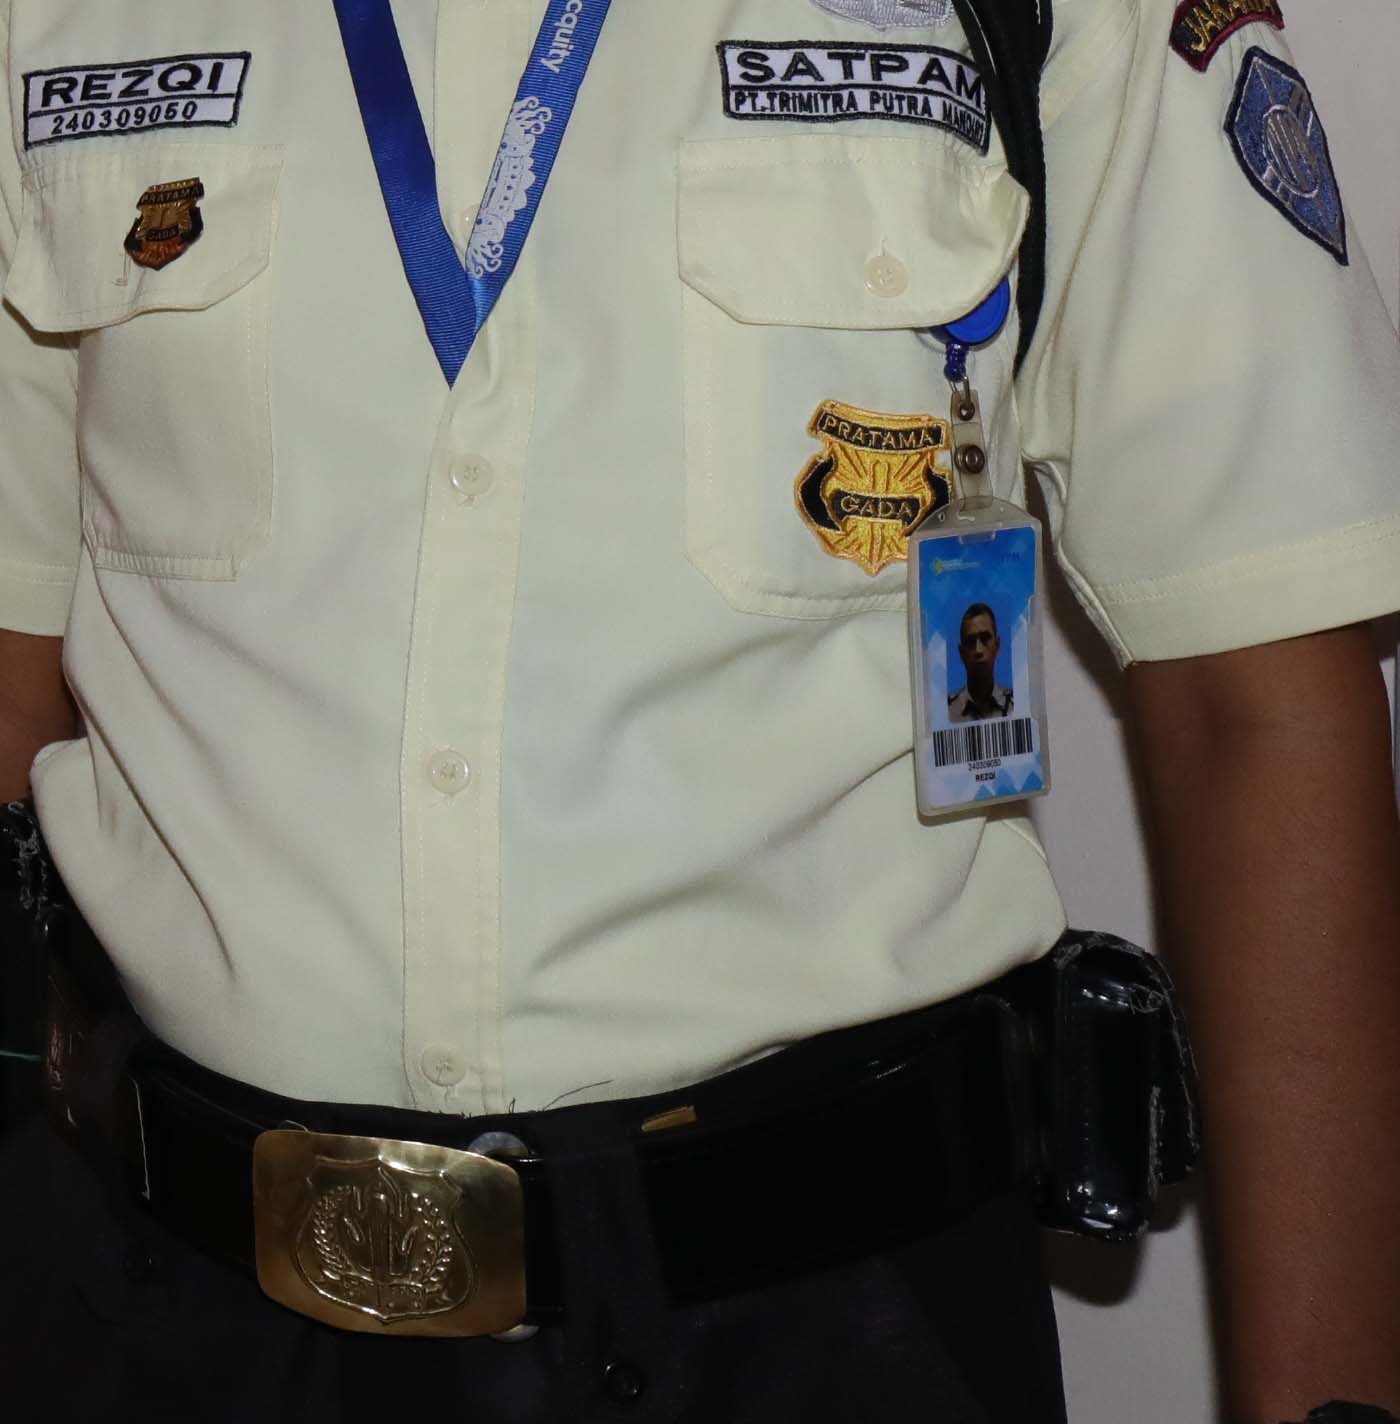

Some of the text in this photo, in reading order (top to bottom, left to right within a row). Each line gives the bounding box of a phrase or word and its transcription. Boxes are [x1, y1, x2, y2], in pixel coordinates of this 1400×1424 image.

[41, 62, 224, 107] REZQI
[736, 51, 983, 110] SATPAM
[51, 100, 198, 135] 240309050
[733, 89, 858, 114] PT.TRIMITRA
[869, 91, 933, 118] PUTRA
[822, 416, 934, 449] PRATAMA
[840, 495, 912, 518] GADA
